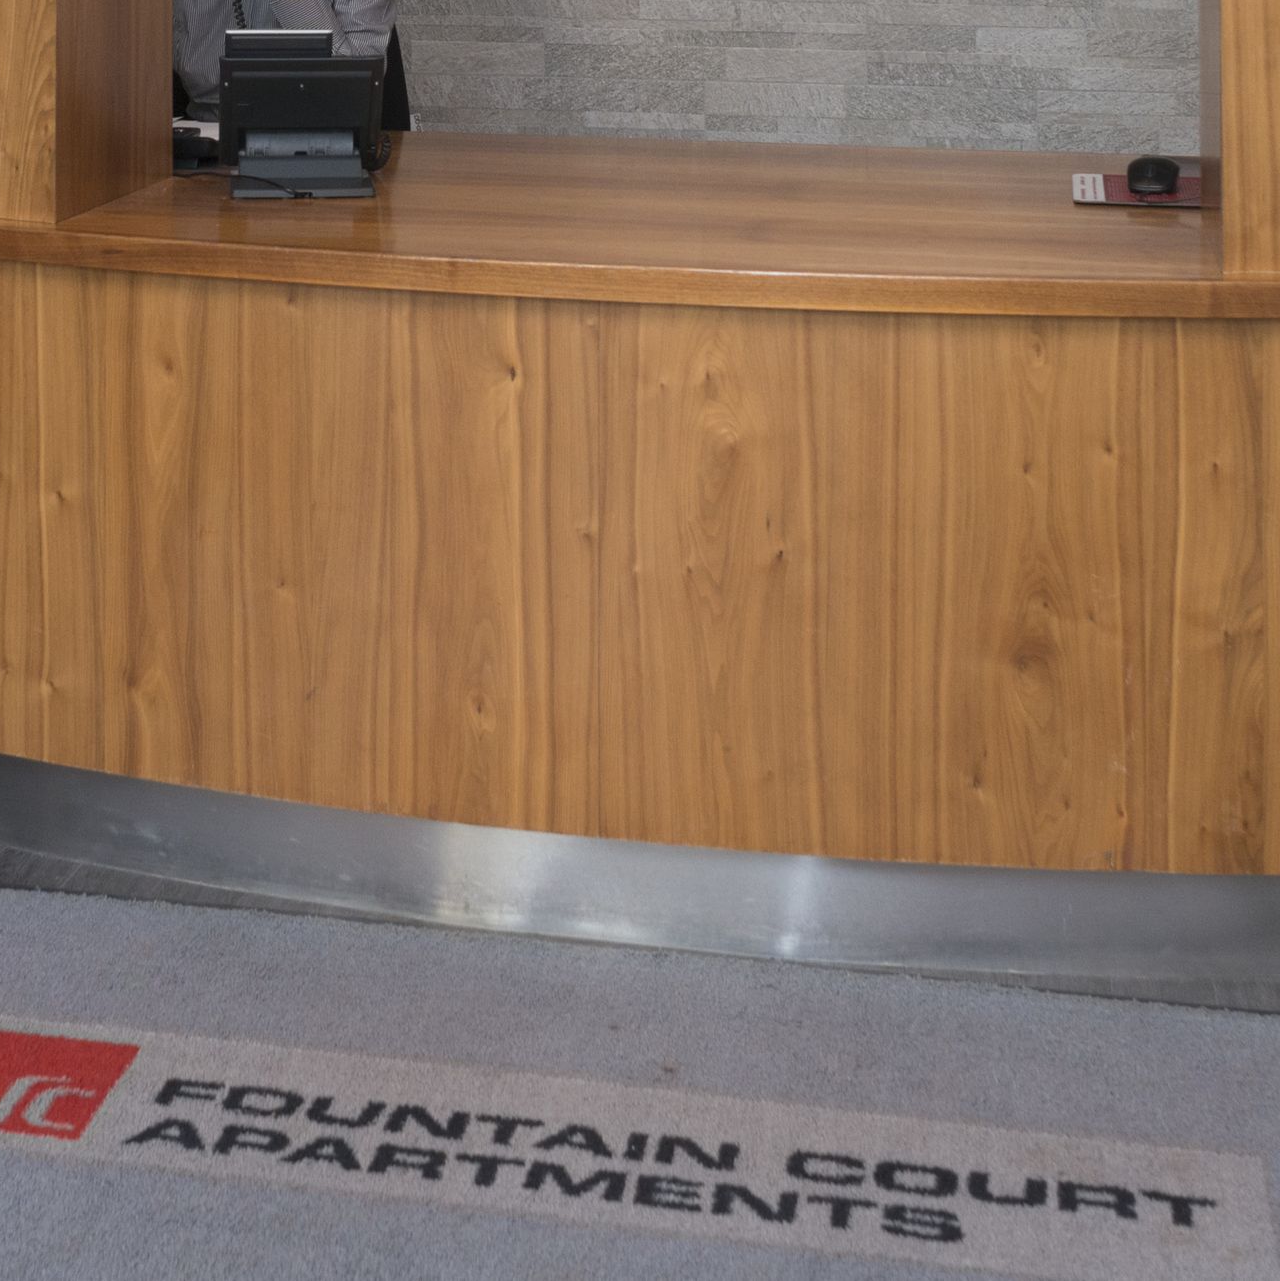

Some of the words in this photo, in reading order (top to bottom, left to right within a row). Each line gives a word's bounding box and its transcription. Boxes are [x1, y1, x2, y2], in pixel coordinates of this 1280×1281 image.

[122, 1118, 964, 1243] APARTMENTS
[153, 1077, 740, 1171] FOUNTAIN
[786, 1149, 1217, 1227] COURT
